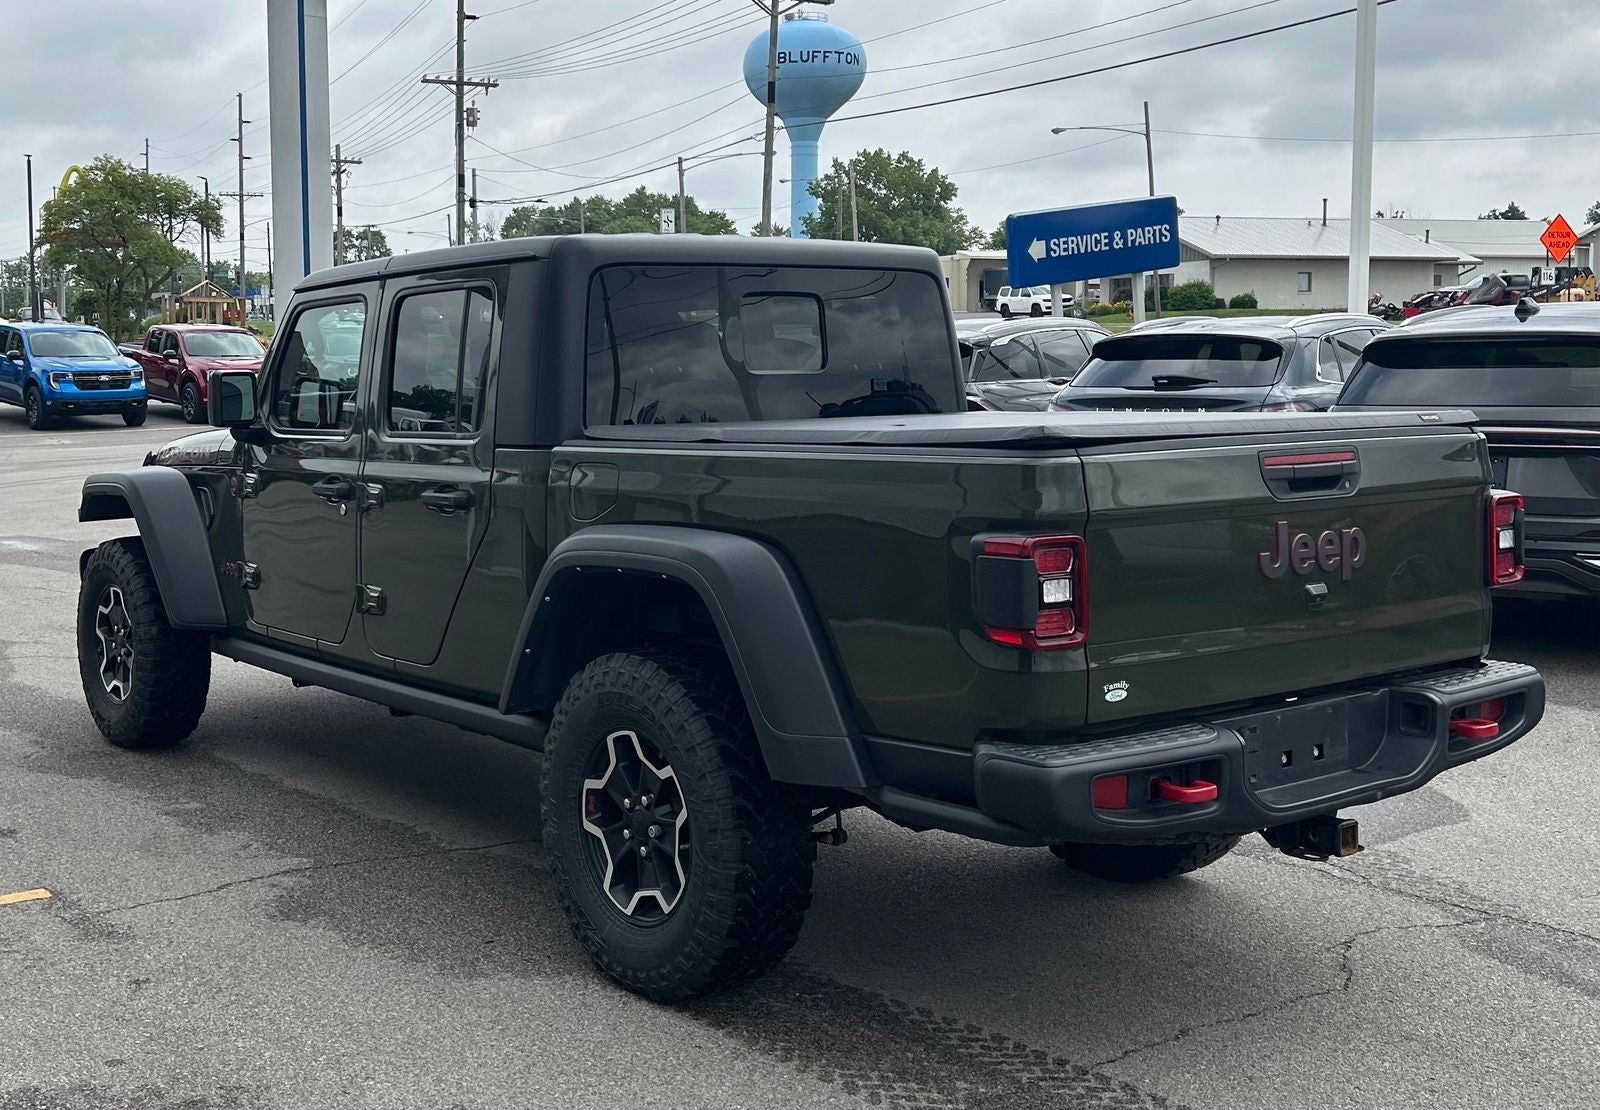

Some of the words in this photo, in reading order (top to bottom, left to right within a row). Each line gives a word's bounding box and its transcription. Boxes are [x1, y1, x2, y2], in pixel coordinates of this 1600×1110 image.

[777, 50, 860, 66] BLUFFTON
[1050, 232, 1110, 258] SERVICE
[1113, 230, 1124, 249] &
[1127, 224, 1171, 247] PARTS
[1548, 231, 1571, 239] DETOUR
[1548, 241, 1571, 249] AHEAD
[1542, 271, 1554, 281] 116
[1259, 520, 1366, 581] Jeep
[1103, 680, 1130, 693] Family
